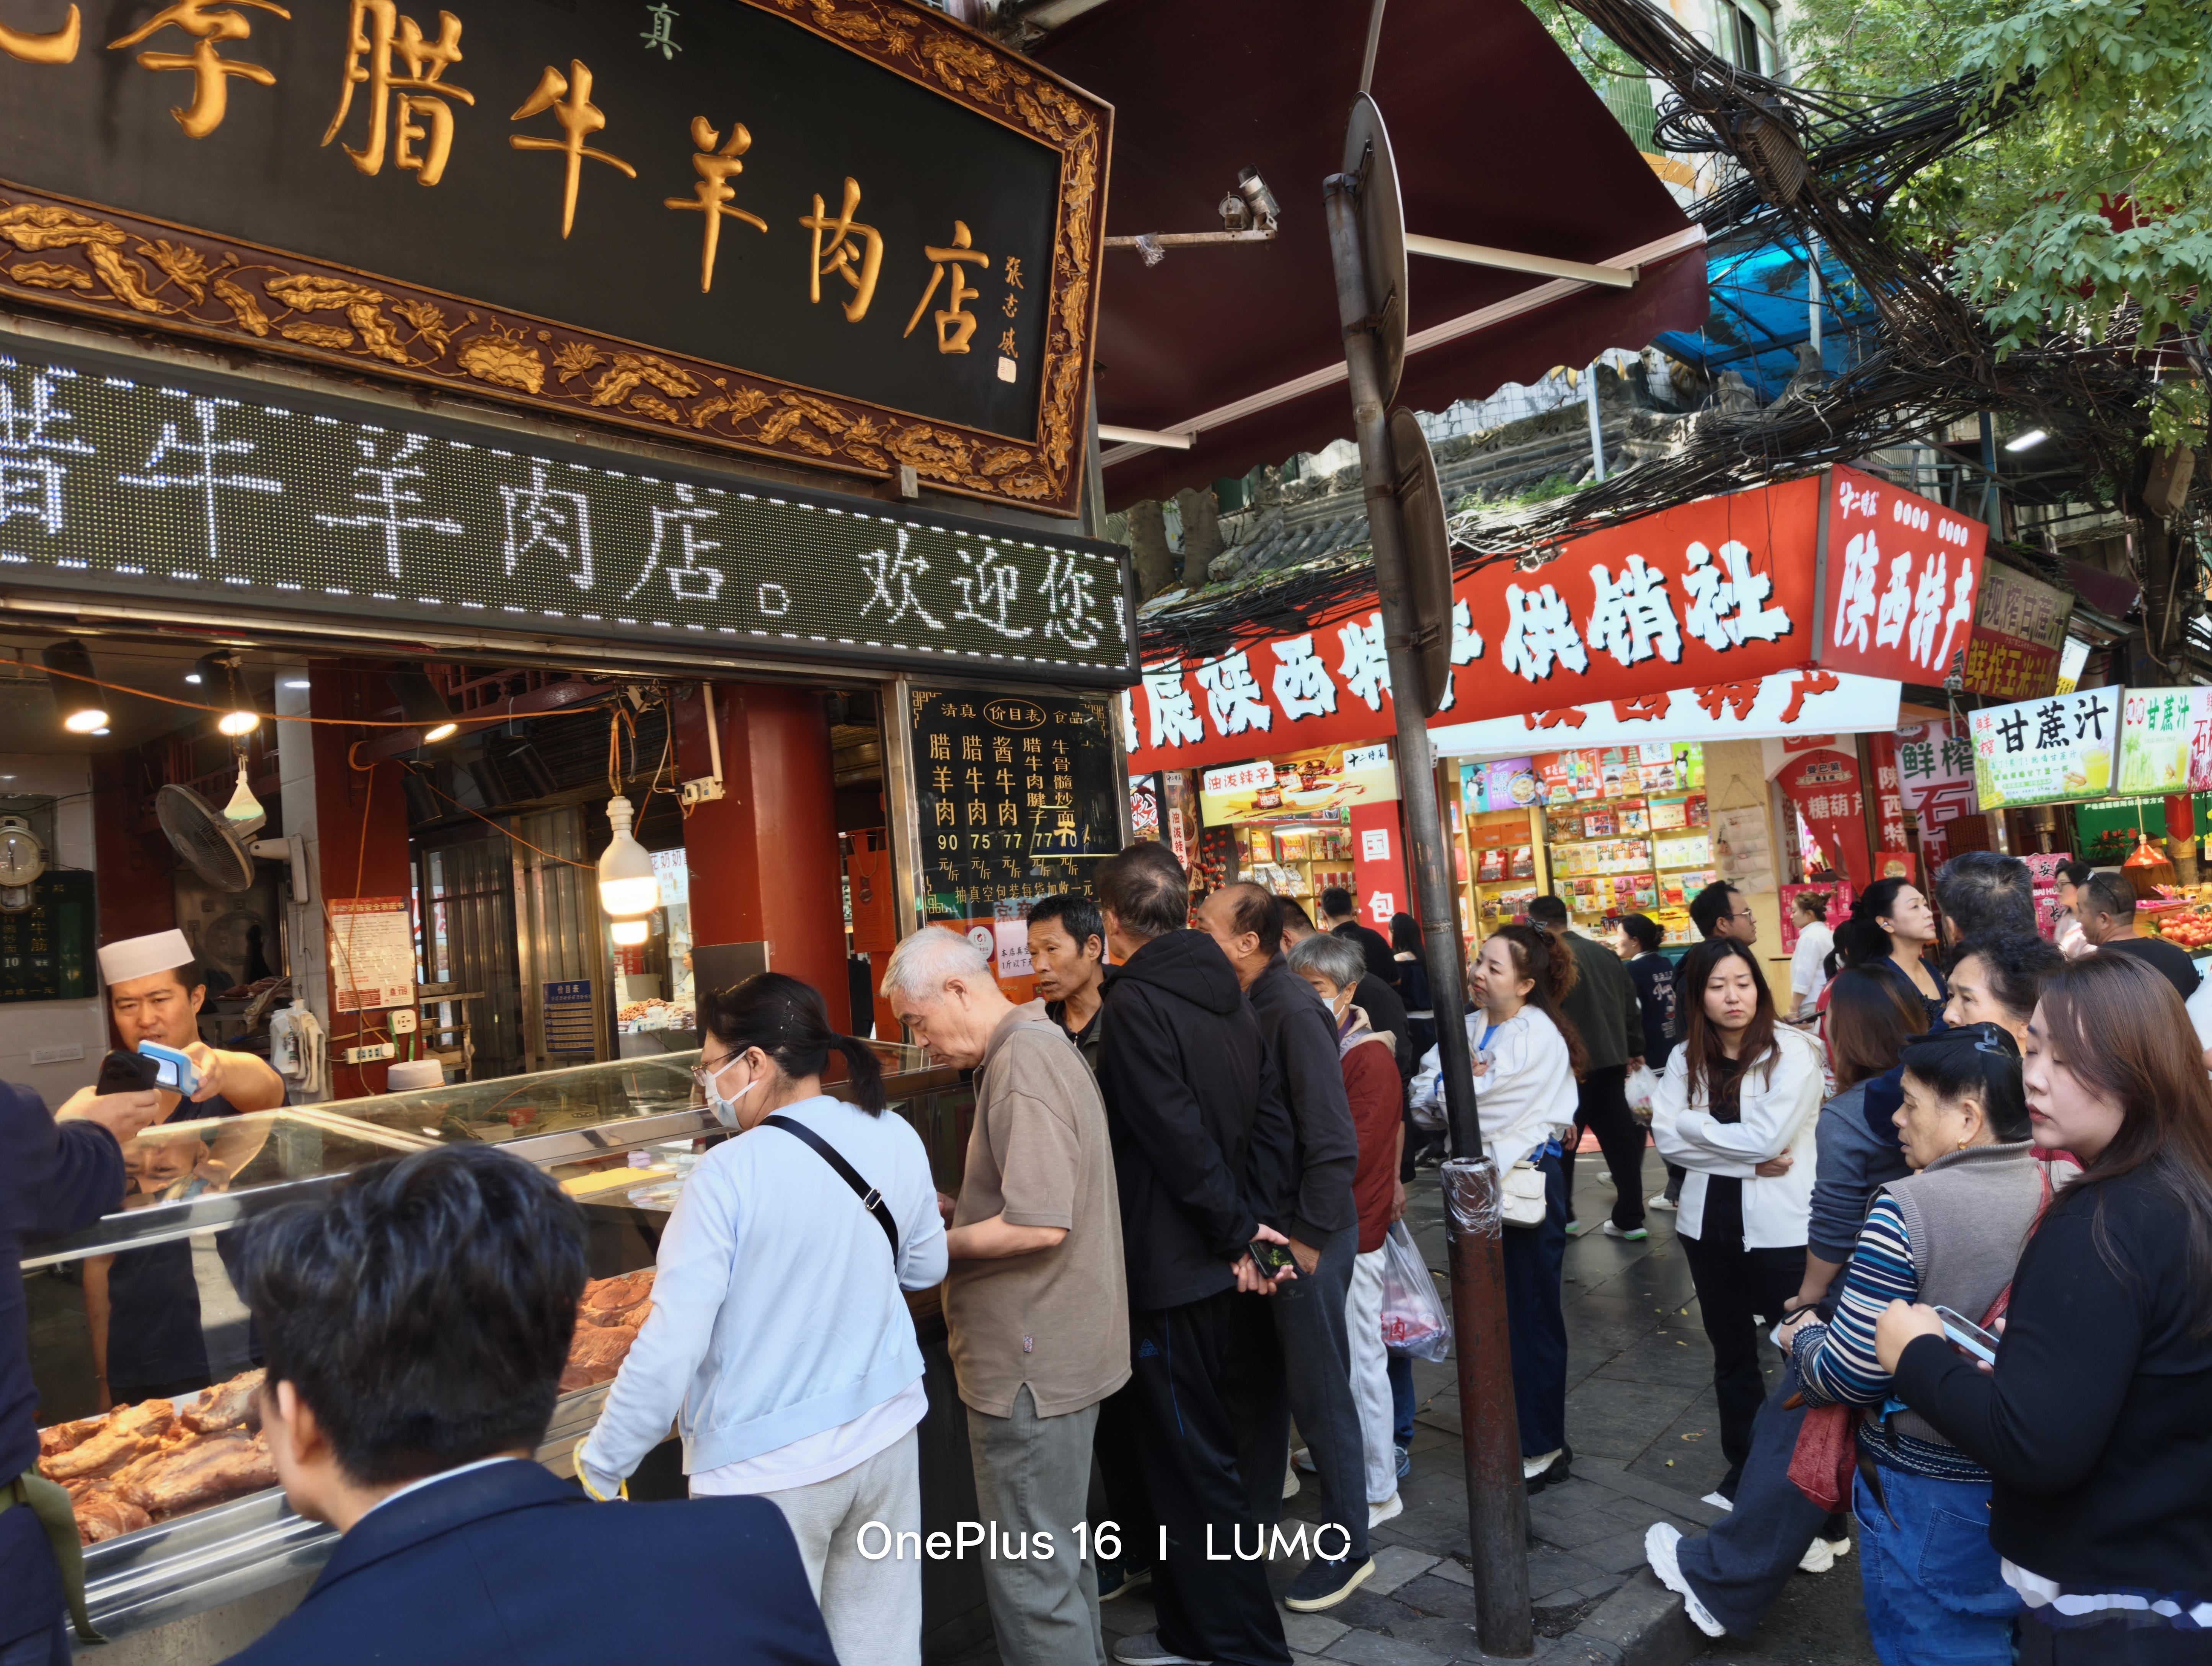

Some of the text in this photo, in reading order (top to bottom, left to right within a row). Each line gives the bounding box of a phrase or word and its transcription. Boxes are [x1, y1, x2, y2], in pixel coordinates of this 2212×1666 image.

[0, 0, 989, 354] 李腊牛羊肉店
[1834, 529, 1973, 671] 陕西特产
[1983, 576, 2065, 647] 现榨甘蔗汁
[1126, 540, 1792, 754] 辰陕西特供销社
[1964, 637, 2047, 699] 鲜榨玉米汁
[941, 703, 1083, 724] 清真 价目表 食品
[1996, 695, 2109, 754] 甘蔗汁
[2147, 694, 2189, 731] 甘蔗汁
[1975, 712, 1995, 758] 鲜榨
[2192, 717, 2212, 758] 石
[930, 733, 955, 826] 腊羊肉
[1208, 767, 1270, 791] 油泼辣子
[1901, 739, 1975, 779] 鲜榨
[962, 735, 987, 826] 腊牛肉
[992, 735, 1018, 826] 酱牛肉
[1023, 737, 1047, 825] 腊牛肉腱子
[1051, 739, 1076, 823] 牛骨髓炒面
[938, 834, 958, 850] 90
[971, 834, 990, 849] 75
[1004, 833, 1022, 848] 77
[1035, 833, 1053, 847] 77
[1171, 812, 1184, 864] 油泼辣子
[938, 858, 959, 881] 元/斤
[971, 857, 991, 880] 元/斤
[1002, 856, 1021, 878] 元/斤
[955, 880, 1093, 904] 抽真空包装每袋加收一元
[5, 957, 20, 968] 10
